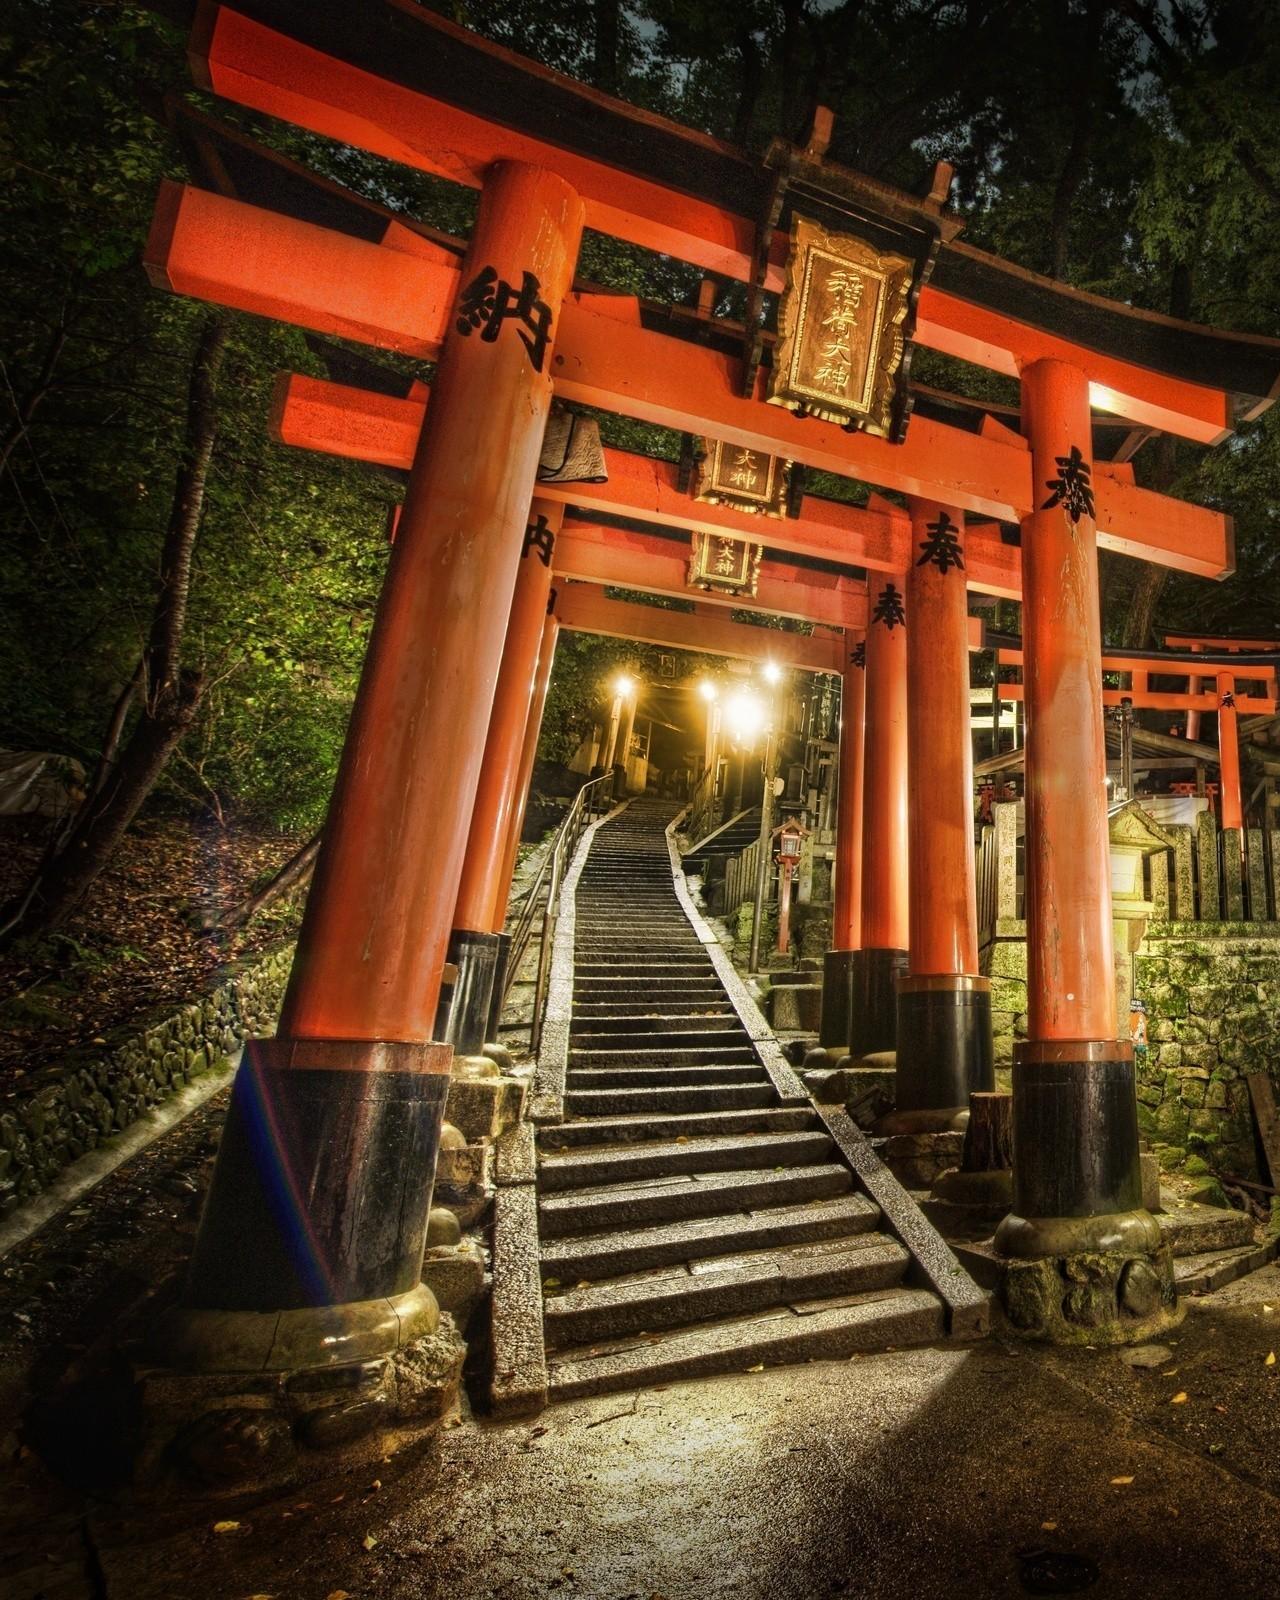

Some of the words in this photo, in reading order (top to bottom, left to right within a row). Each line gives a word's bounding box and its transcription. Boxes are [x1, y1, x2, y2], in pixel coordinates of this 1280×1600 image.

[456, 265, 552, 374] 納
[1040, 445, 1096, 523] 奉
[916, 511, 965, 575] 奉
[872, 583, 905, 630] 奉
